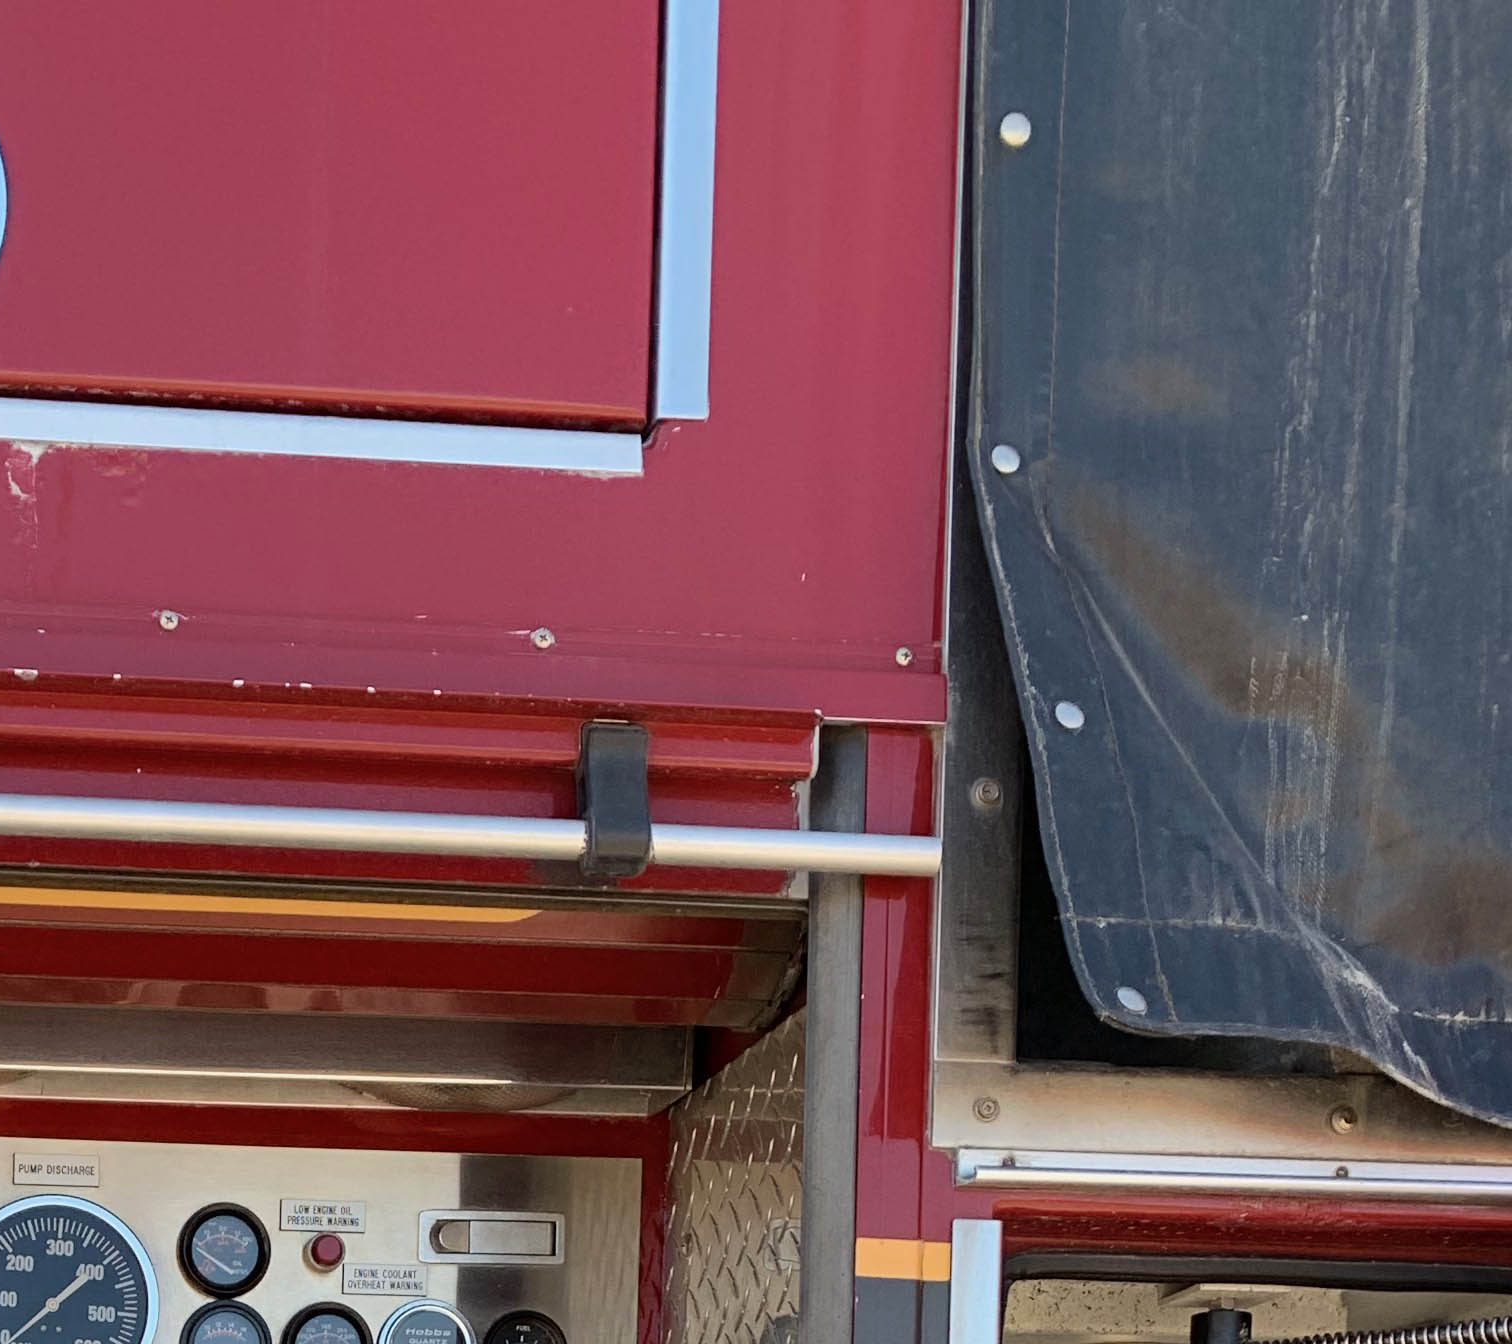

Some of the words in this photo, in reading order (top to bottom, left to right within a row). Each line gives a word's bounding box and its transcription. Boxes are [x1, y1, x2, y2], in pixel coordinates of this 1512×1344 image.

[18, 1163, 44, 1175] PUMP
[46, 1164, 96, 1176] DISCHARGE
[293, 1204, 310, 1215] LOW
[313, 1205, 338, 1216] ENGINE
[340, 1206, 353, 1216] OIL
[287, 1215, 324, 1226] PRESSURE
[327, 1216, 360, 1227] WARNING
[46, 1238, 74, 1257] 300
[5, 1254, 35, 1273] 200
[75, 1263, 105, 1281] 400
[353, 1268, 380, 1279] ENGINE
[382, 1269, 418, 1280] COOLANT
[347, 1279, 387, 1290] OVERHEAT
[389, 1280, 424, 1291] WARNING
[87, 1305, 116, 1323] 500
[405, 1327, 452, 1337] Hobbs
